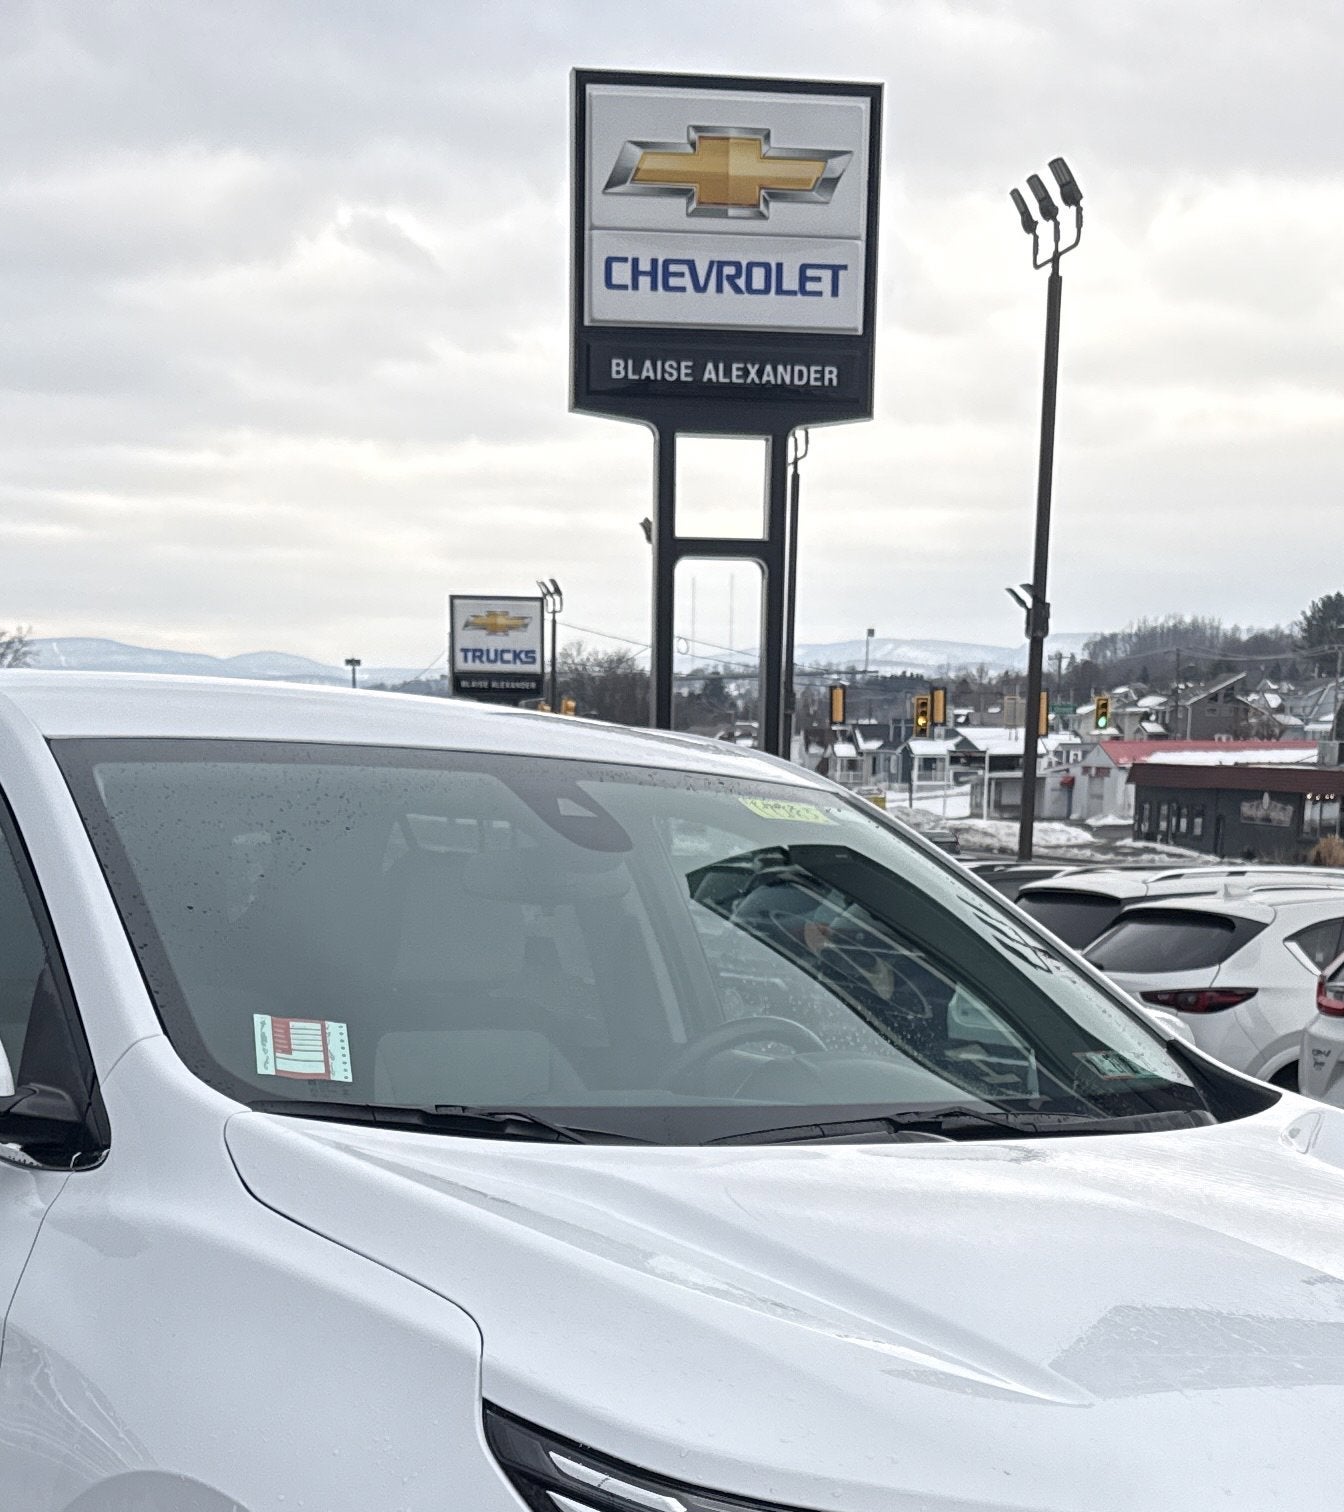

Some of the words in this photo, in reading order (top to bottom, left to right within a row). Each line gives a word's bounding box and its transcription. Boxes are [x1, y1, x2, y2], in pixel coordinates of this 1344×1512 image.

[604, 256, 849, 298] CHEVROLET
[610, 358, 694, 382] BLAISE
[702, 361, 839, 387] ALEXANDER
[460, 648, 537, 665] TRUCKS
